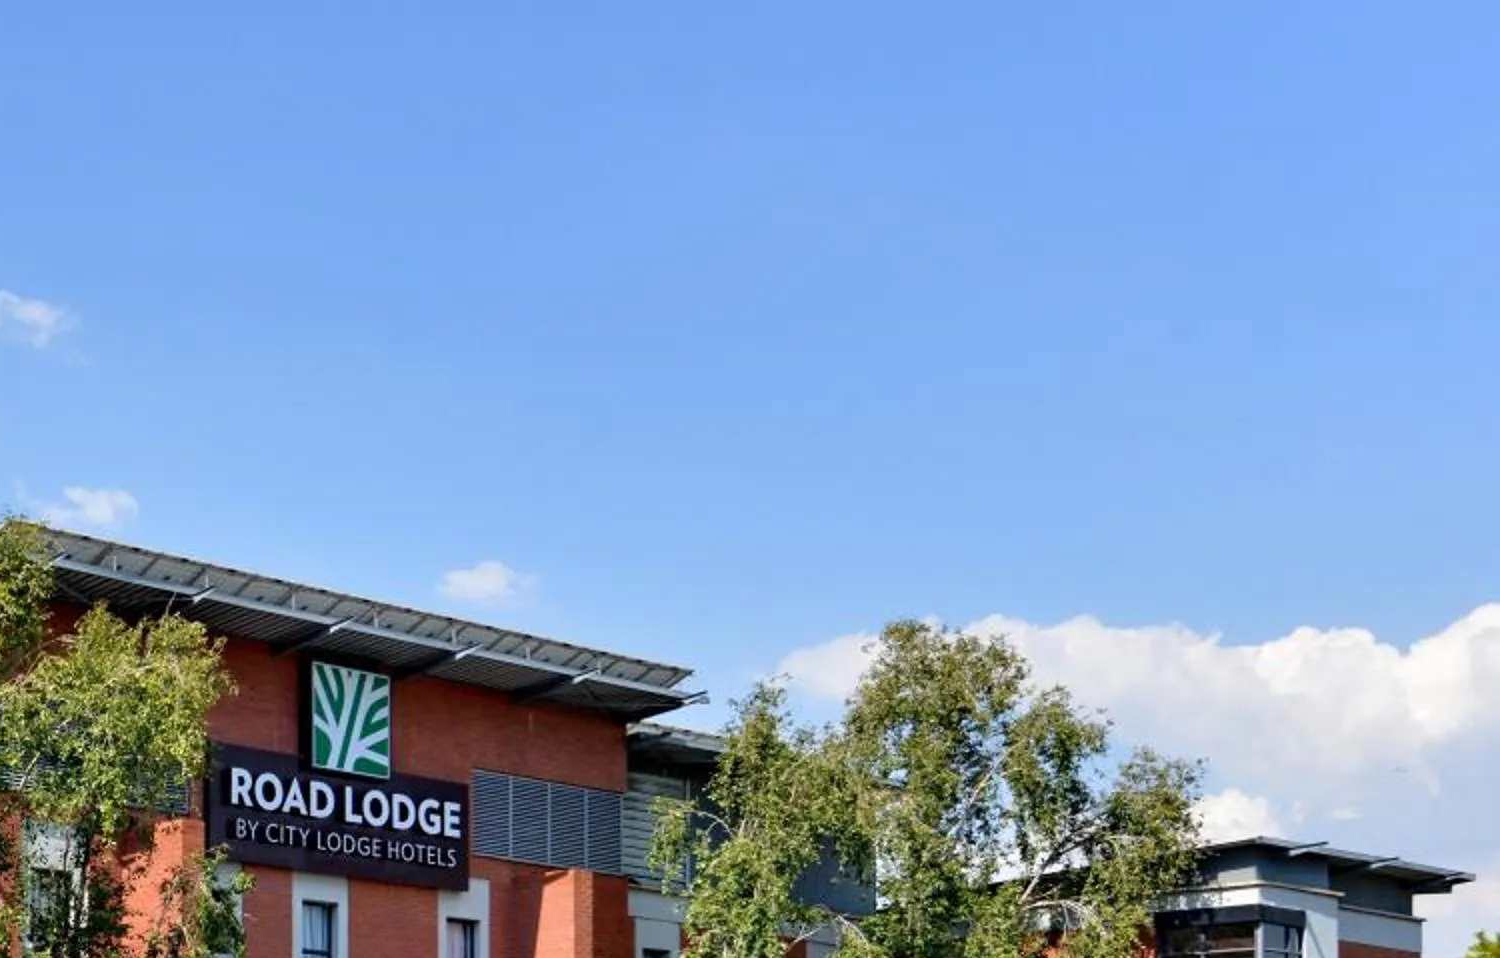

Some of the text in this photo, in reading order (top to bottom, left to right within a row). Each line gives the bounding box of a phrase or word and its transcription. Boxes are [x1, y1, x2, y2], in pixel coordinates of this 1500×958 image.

[230, 767, 461, 838] ROAD LODGE
[235, 817, 457, 868] BY CITY LODGE HOTELS
